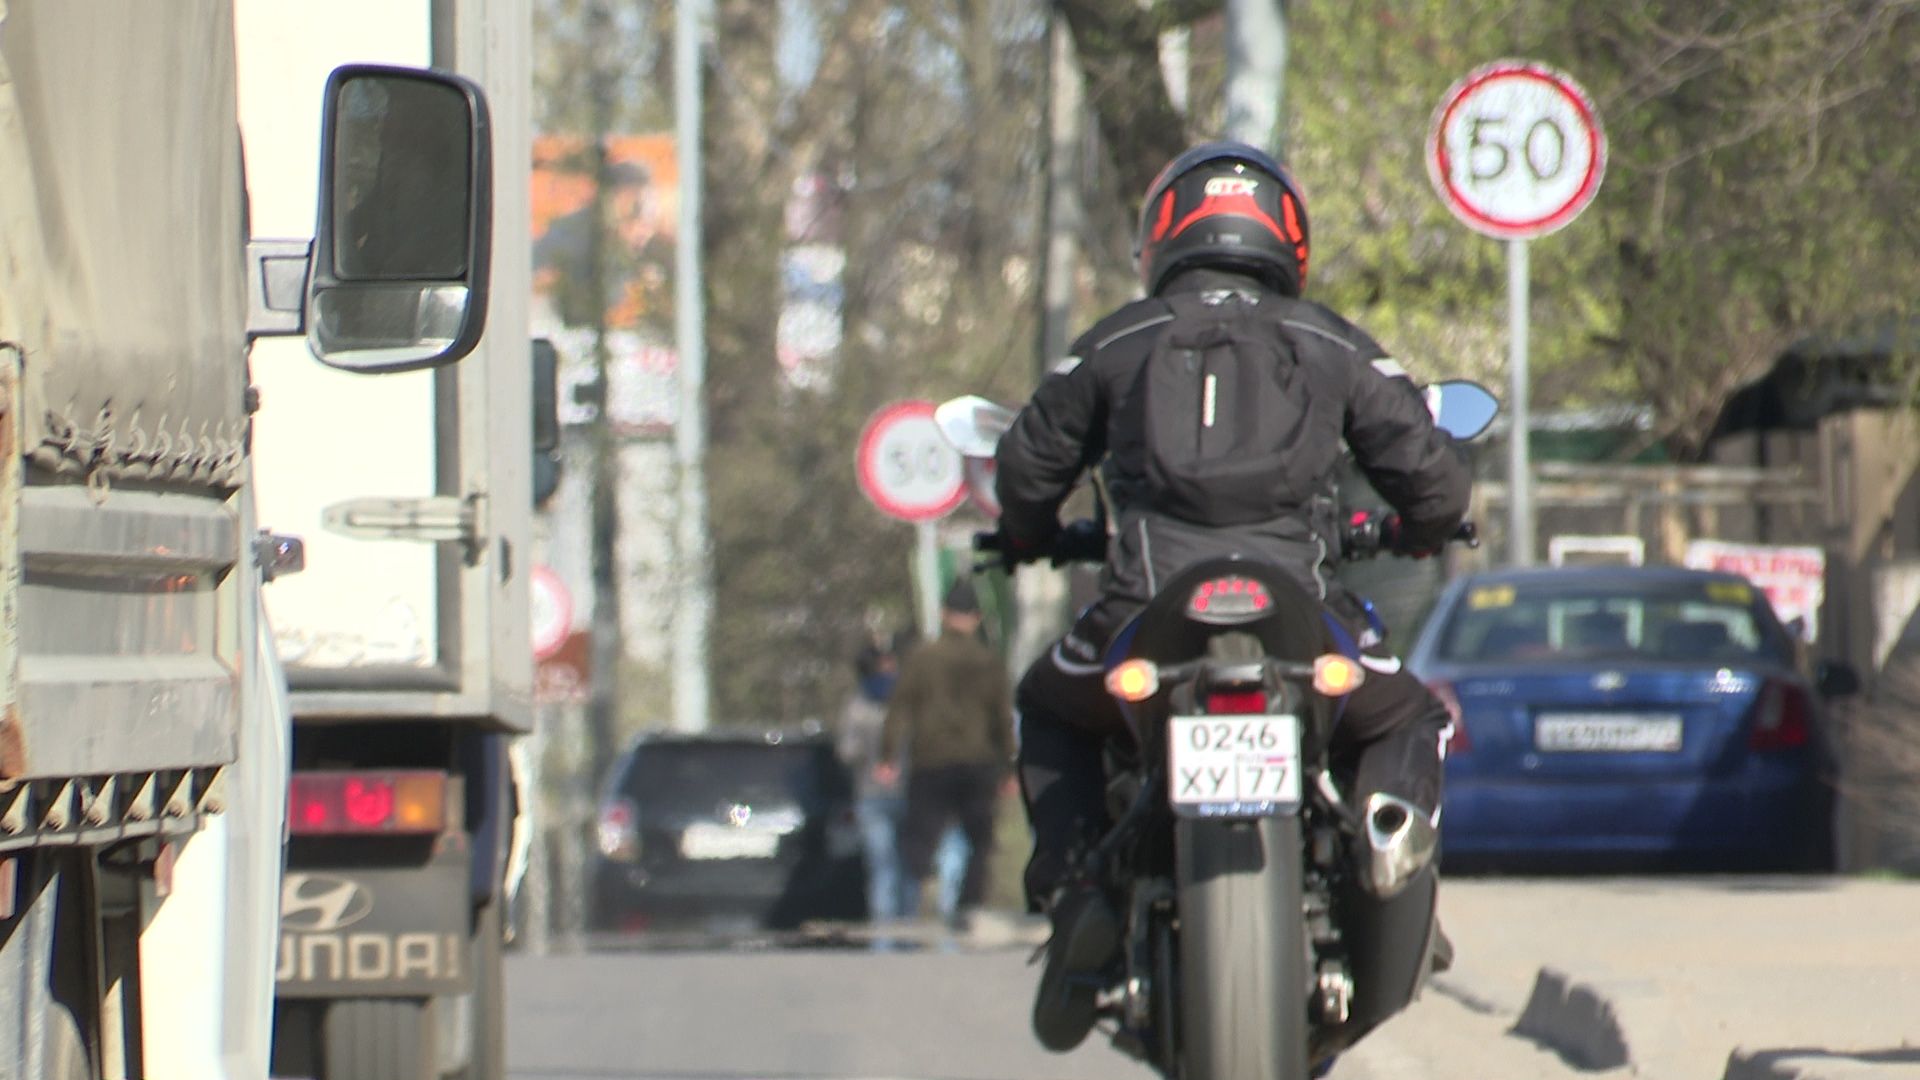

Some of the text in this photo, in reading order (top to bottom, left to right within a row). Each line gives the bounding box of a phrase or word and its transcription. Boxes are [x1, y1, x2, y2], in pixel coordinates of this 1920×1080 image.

[1470, 117, 1565, 181] 50
[1190, 722, 1278, 752] 0246
[1245, 766, 1288, 795] 77
